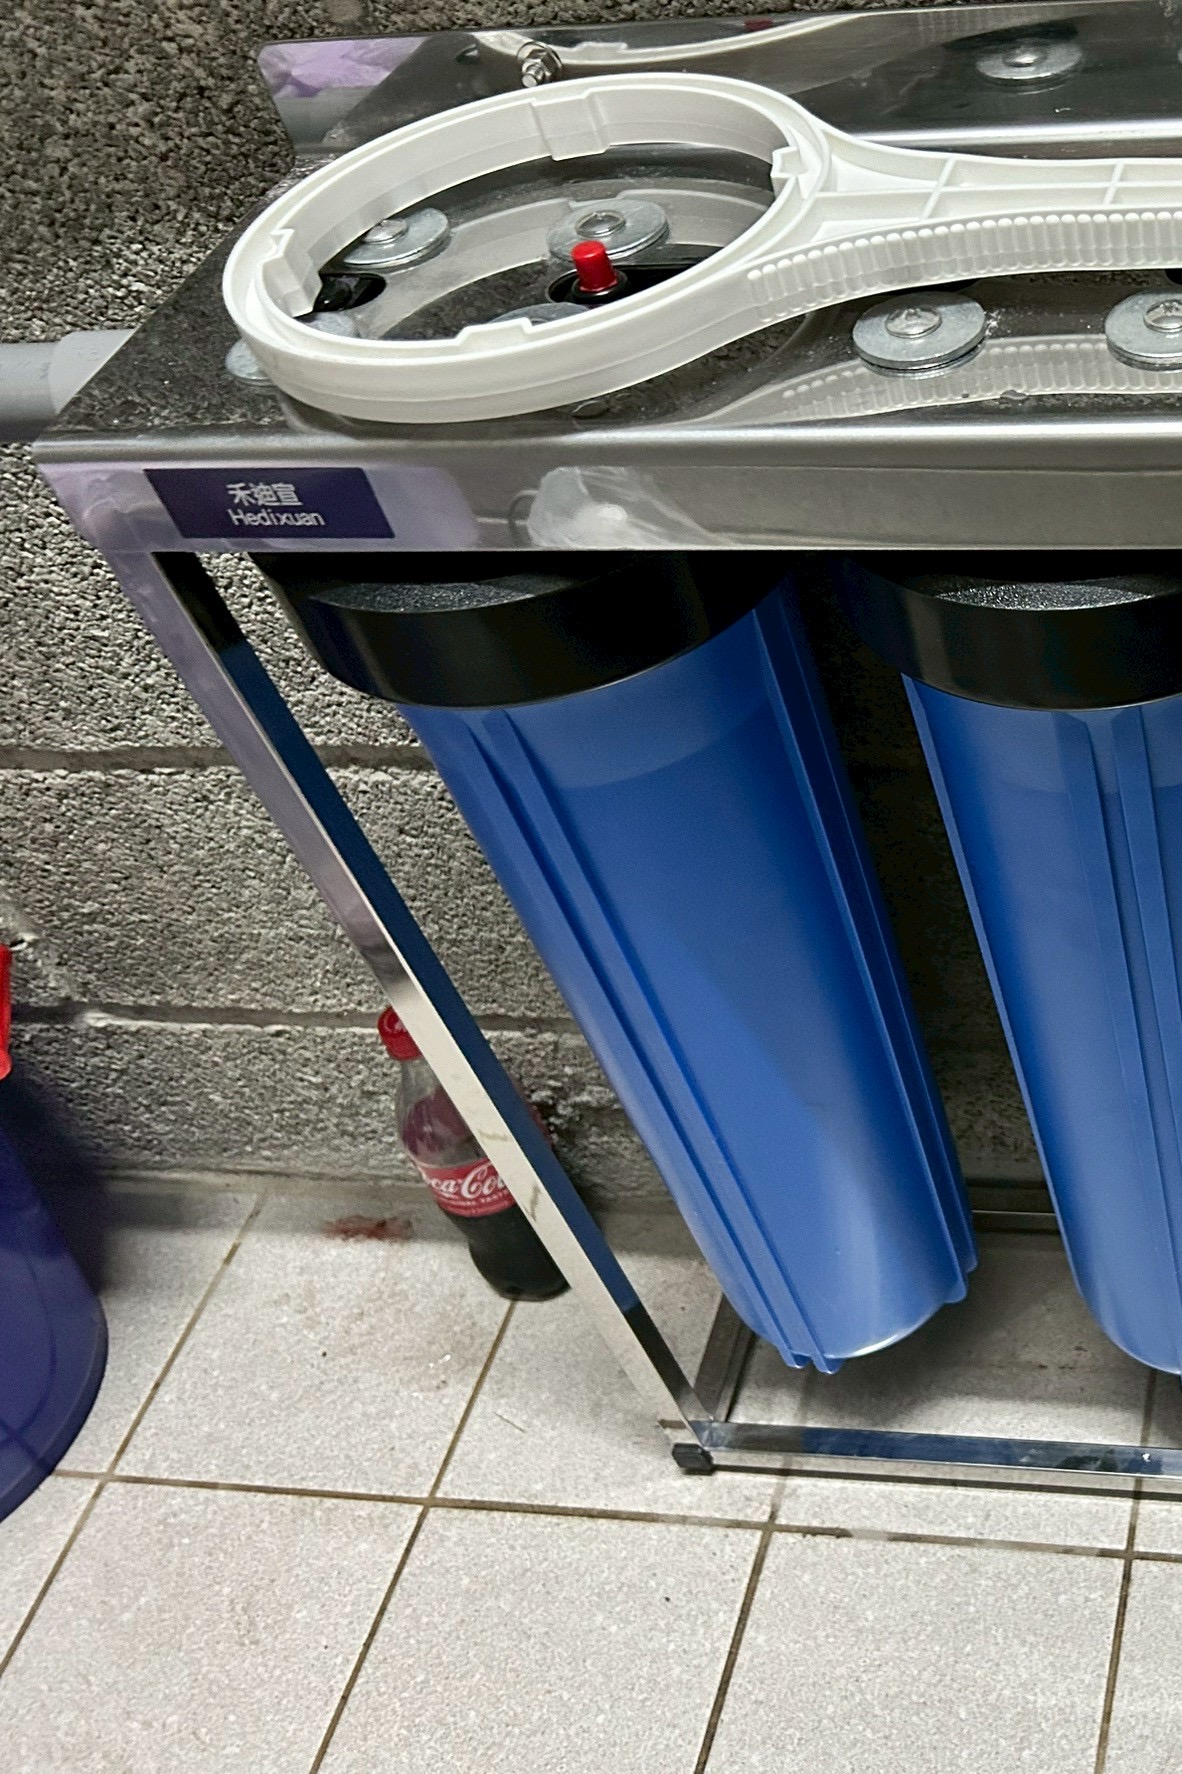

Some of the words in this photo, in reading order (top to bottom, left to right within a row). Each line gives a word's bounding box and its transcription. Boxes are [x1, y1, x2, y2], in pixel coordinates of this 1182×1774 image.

[226, 482, 303, 506] 禾迪宣
[227, 508, 326, 526] Hedixuan
